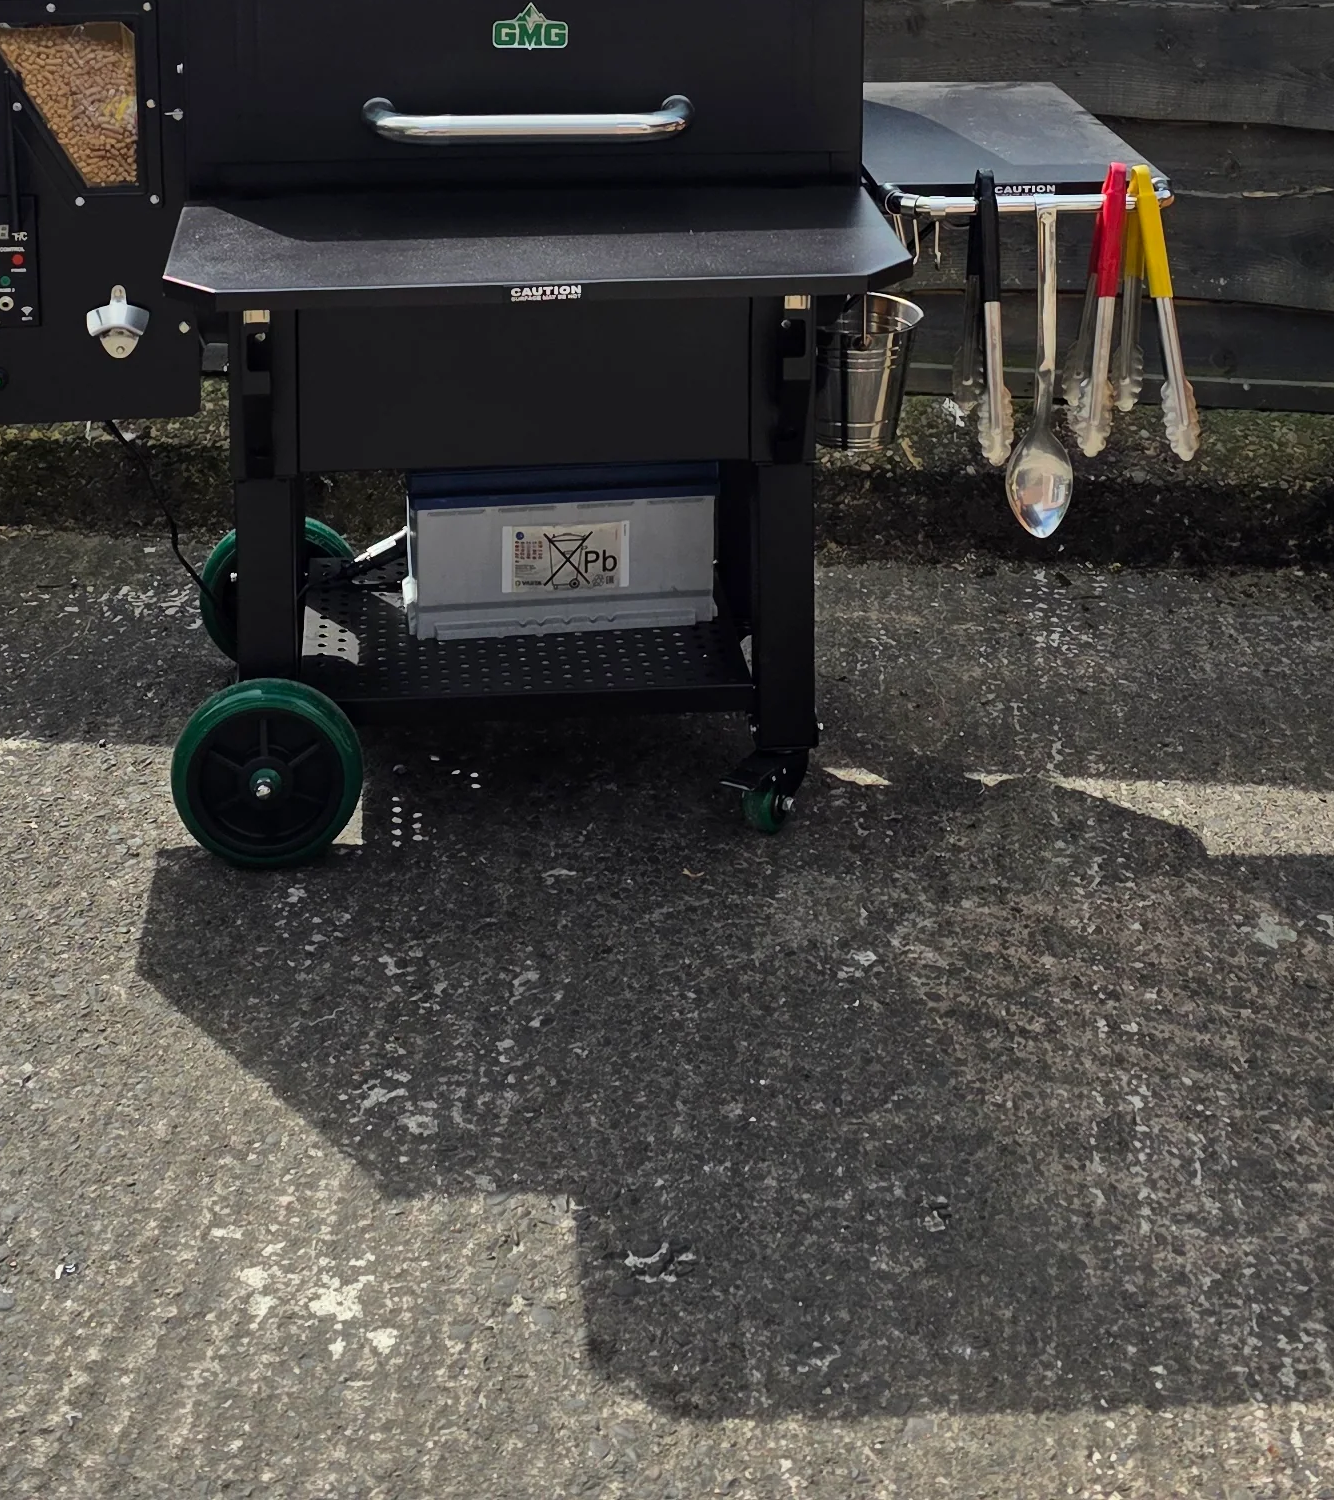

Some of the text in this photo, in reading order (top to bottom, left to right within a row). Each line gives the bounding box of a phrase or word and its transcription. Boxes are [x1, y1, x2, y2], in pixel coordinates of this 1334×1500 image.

[494, 21, 567, 48] GMG
[994, 184, 1056, 194] CAUTION
[510, 284, 582, 297] CAUTION
[584, 549, 618, 574] Pb
